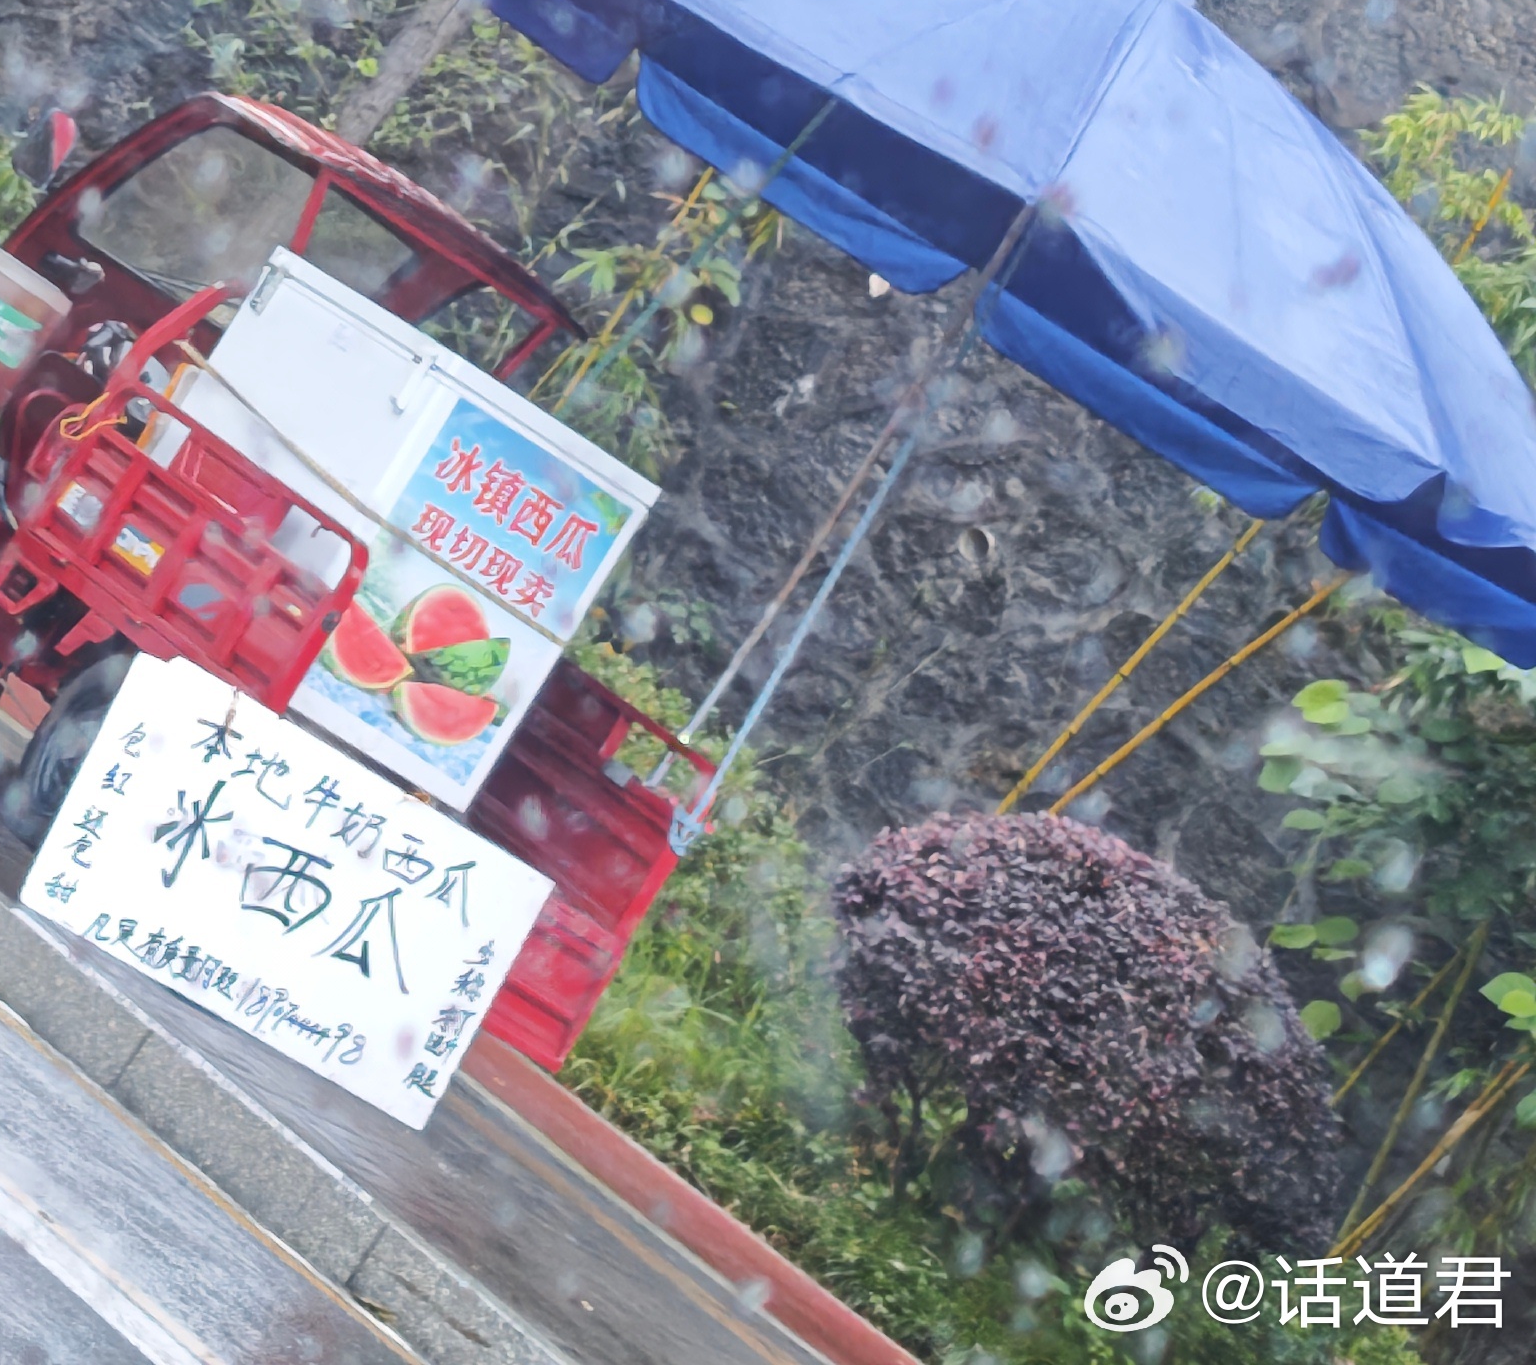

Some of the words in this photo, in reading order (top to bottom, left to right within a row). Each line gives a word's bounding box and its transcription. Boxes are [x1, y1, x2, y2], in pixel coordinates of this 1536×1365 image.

[411, 503, 555, 618] 现切现卖
[434, 437, 599, 570] 冰镇西瓜
[151, 780, 409, 995] 冰西瓜
[191, 718, 476, 928] 本地牛奶西瓜
